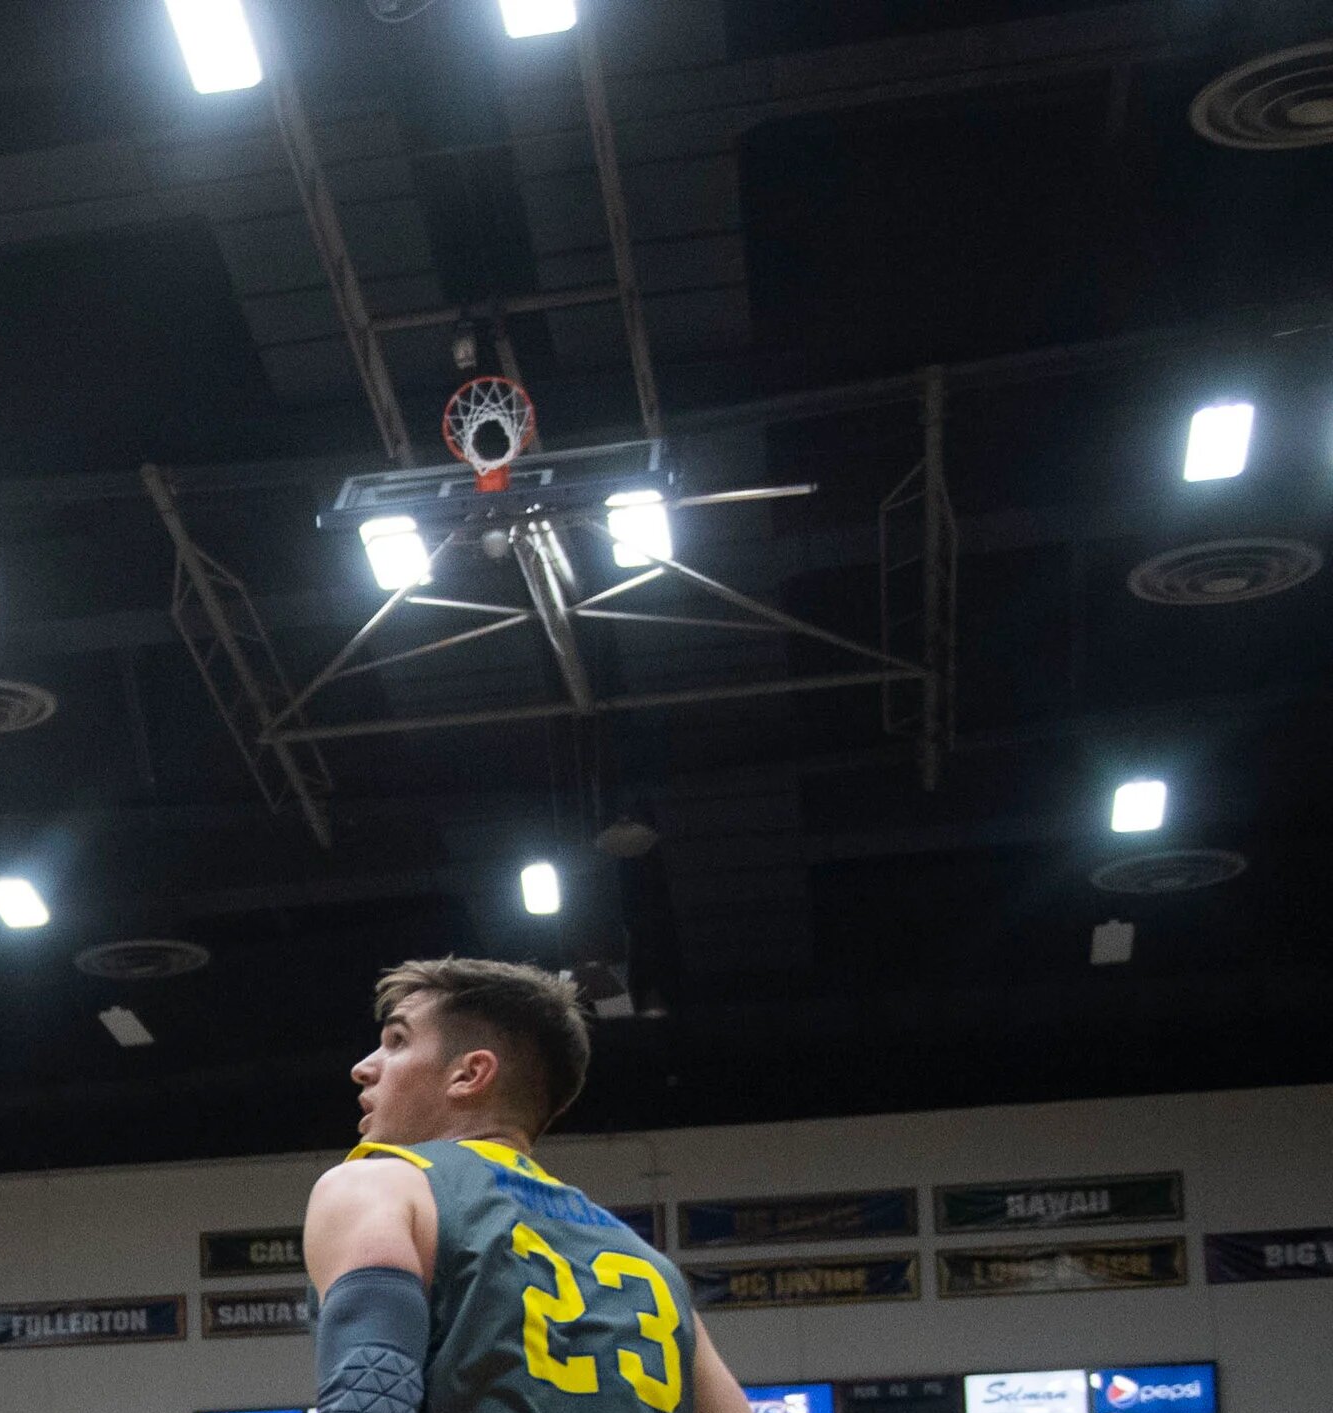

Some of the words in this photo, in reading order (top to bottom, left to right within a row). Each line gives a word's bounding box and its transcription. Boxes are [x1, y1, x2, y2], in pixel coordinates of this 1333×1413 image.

[249, 1240, 300, 1263] CAL
[1264, 1242, 1317, 1267] BIG
[9, 1309, 147, 1338] FULLERTON
[218, 1301, 292, 1326] SANTA
[511, 1221, 683, 1413] 23
[1140, 1380, 1202, 1405] pepsi
